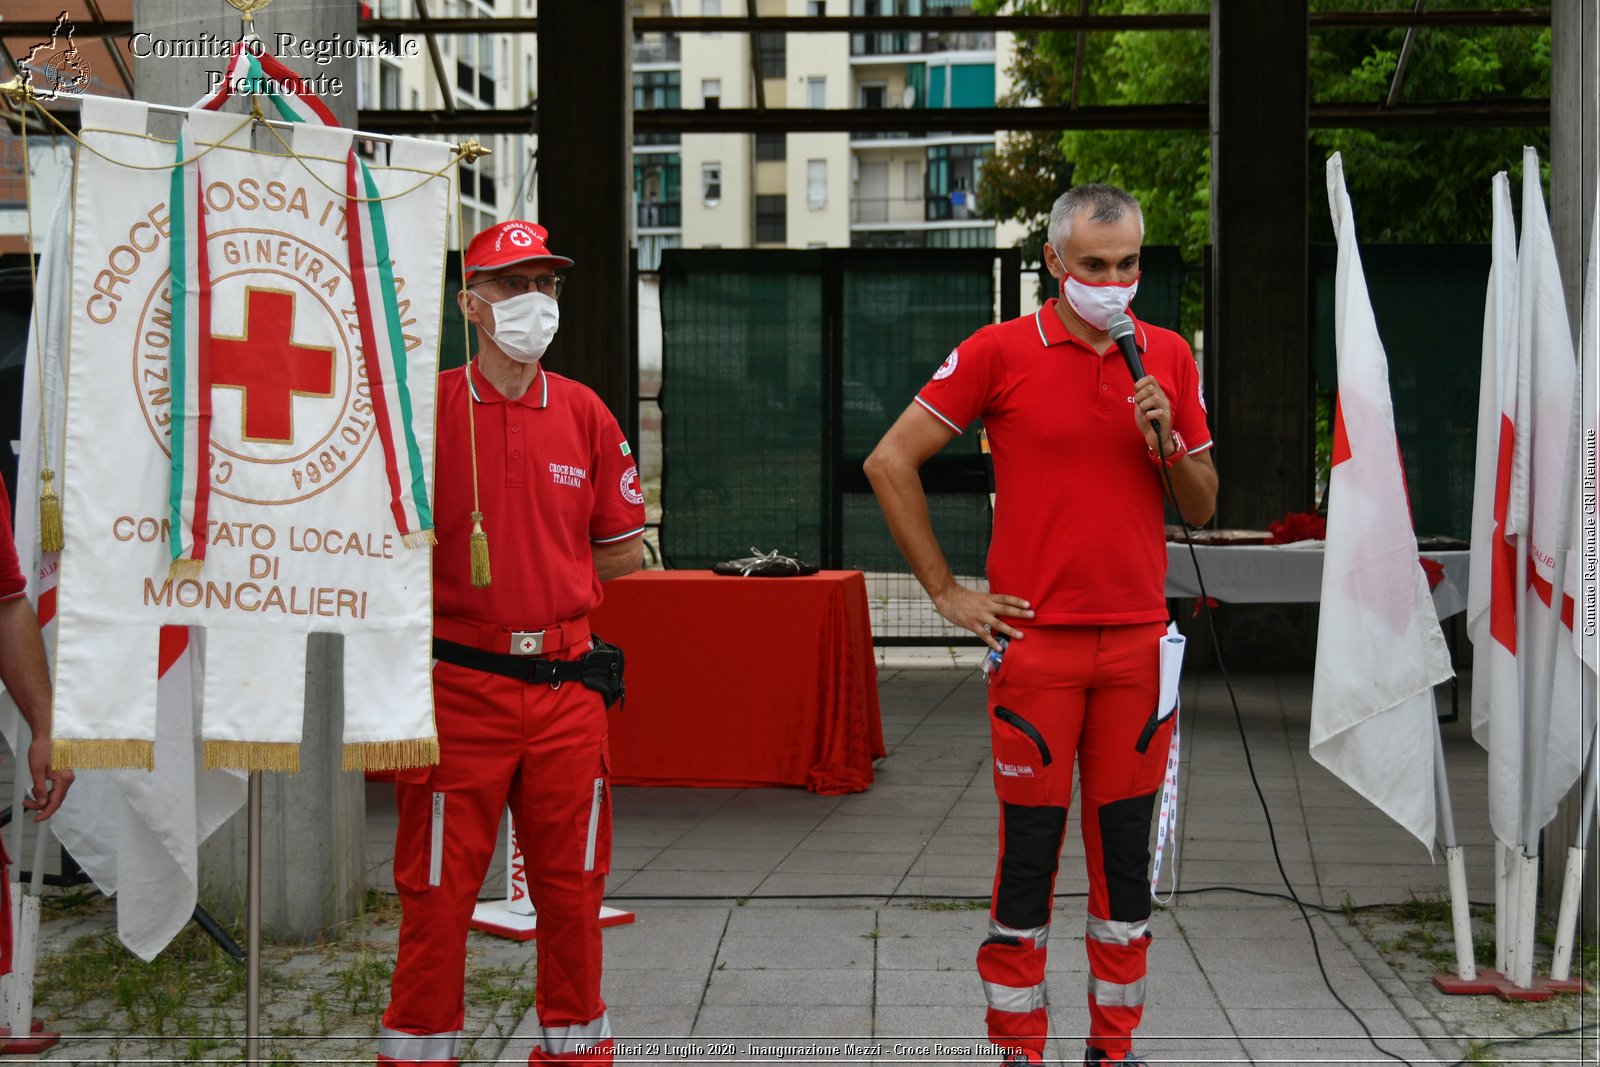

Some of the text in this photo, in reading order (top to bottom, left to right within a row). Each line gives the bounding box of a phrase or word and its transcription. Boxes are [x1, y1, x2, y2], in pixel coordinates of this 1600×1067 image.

[503, 222, 524, 232] ROSSA
[87, 202, 170, 325] CROCE
[203, 178, 310, 220] OSSA
[223, 239, 341, 298] GINEVRA
[291, 445, 347, 490] 1864
[549, 462, 586, 479] CROCE ROSSA
[113, 516, 395, 559] COMTATO LOCALE
[249, 554, 280, 580] DI
[143, 577, 368, 619] MONCALIERI
